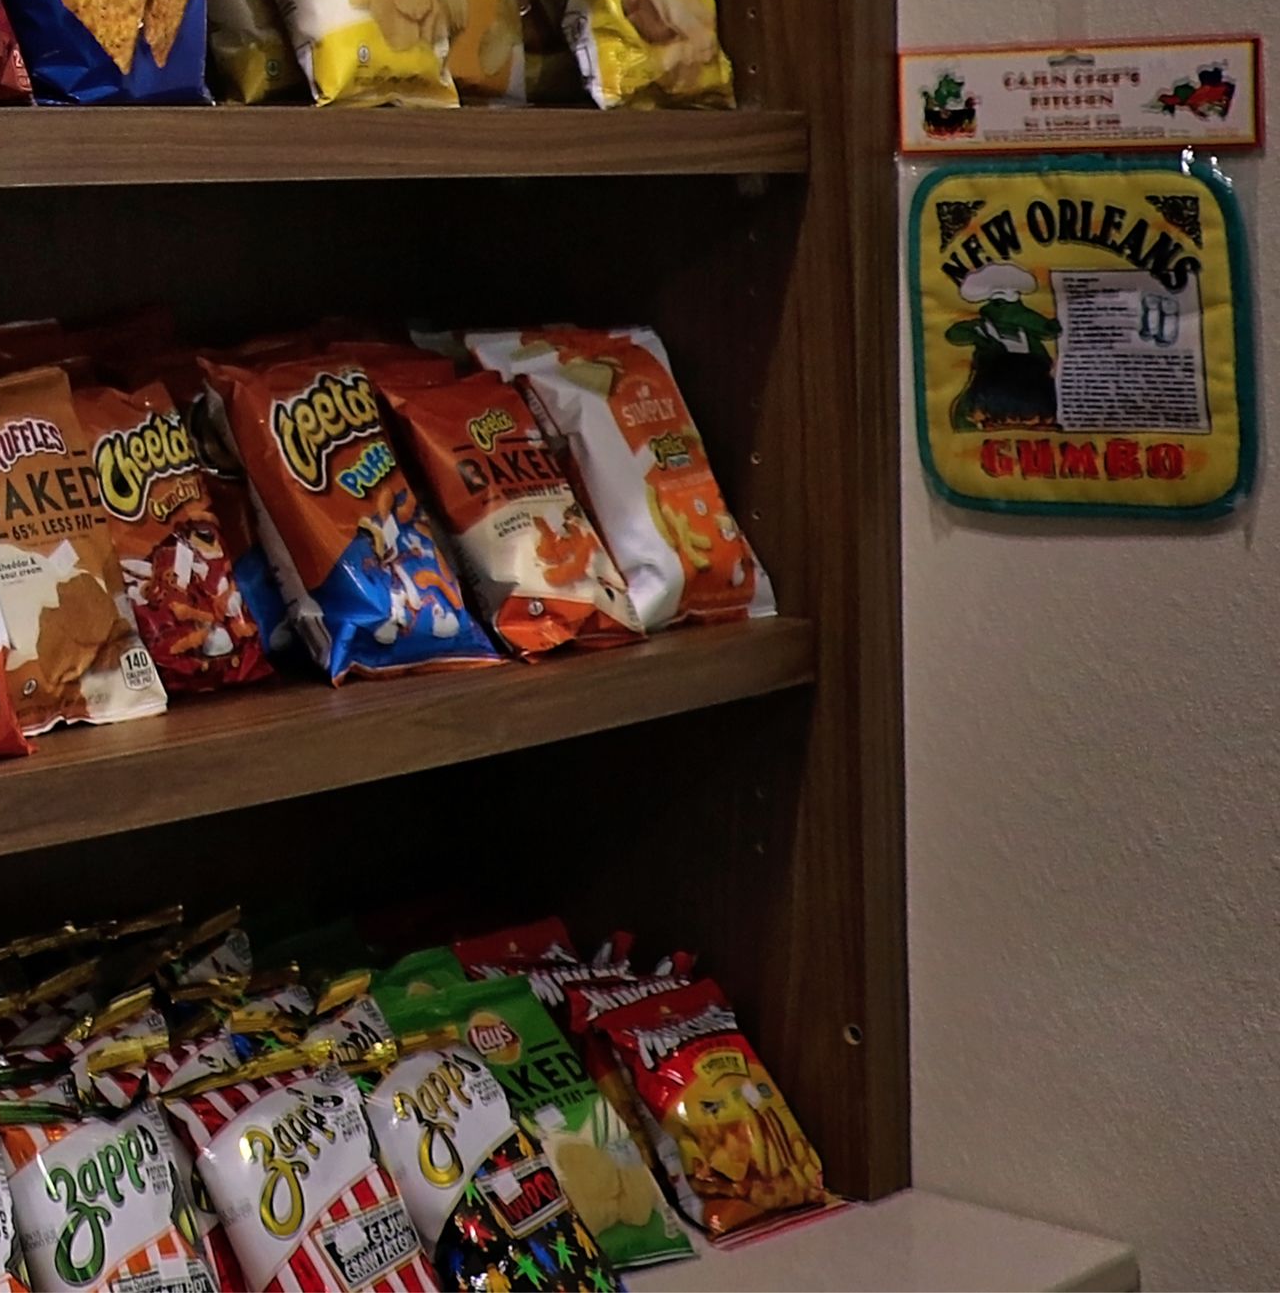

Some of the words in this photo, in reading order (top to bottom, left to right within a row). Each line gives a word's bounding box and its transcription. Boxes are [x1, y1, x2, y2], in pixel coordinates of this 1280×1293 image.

[941, 210, 1021, 289] NEW
[1026, 198, 1202, 294] ORLEANS
[467, 408, 516, 453] Cheetos
[623, 397, 677, 427] SIMPLY
[980, 438, 1186, 481] GUMBO
[44, 520, 75, 536] LESS
[77, 515, 95, 530] FAT
[124, 651, 149, 670] 140
[472, 1023, 514, 1055] Lay's
[504, 1051, 589, 1102] AKED
